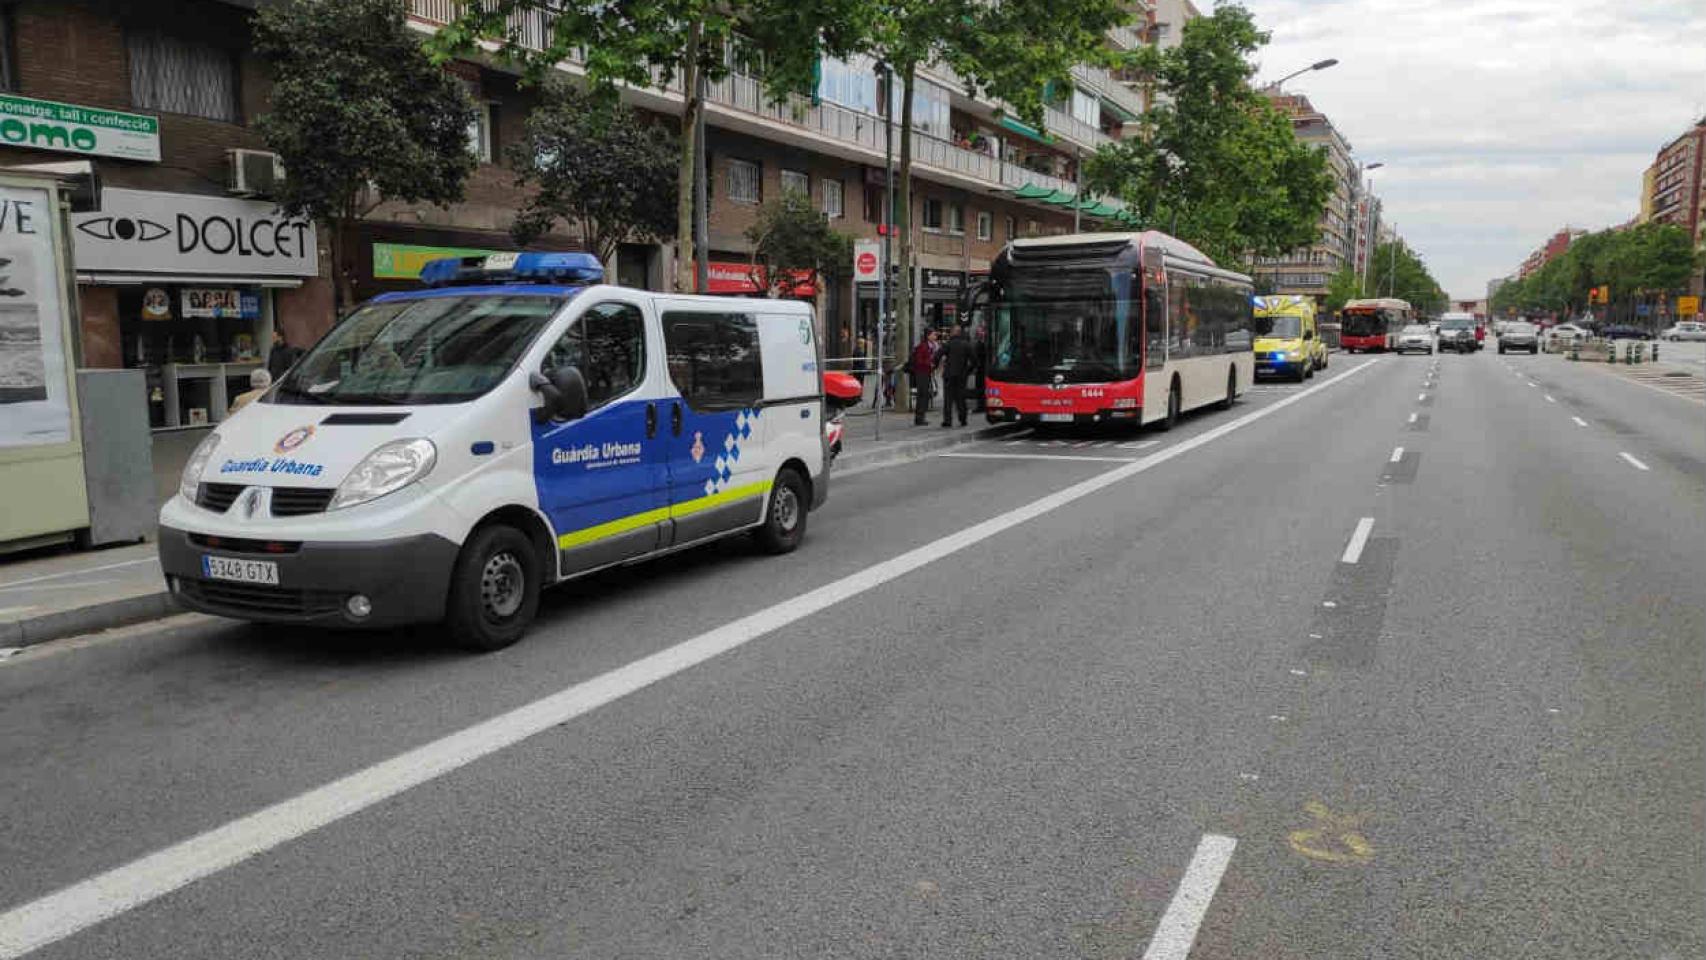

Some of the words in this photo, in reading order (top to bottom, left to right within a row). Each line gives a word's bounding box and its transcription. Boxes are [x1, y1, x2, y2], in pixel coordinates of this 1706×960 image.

[60, 108, 79, 120] tall
[176, 213, 308, 258] DOLCET
[602, 441, 641, 459] Urbana
[271, 456, 323, 476] Urbana
[246, 563, 274, 581] GTX
